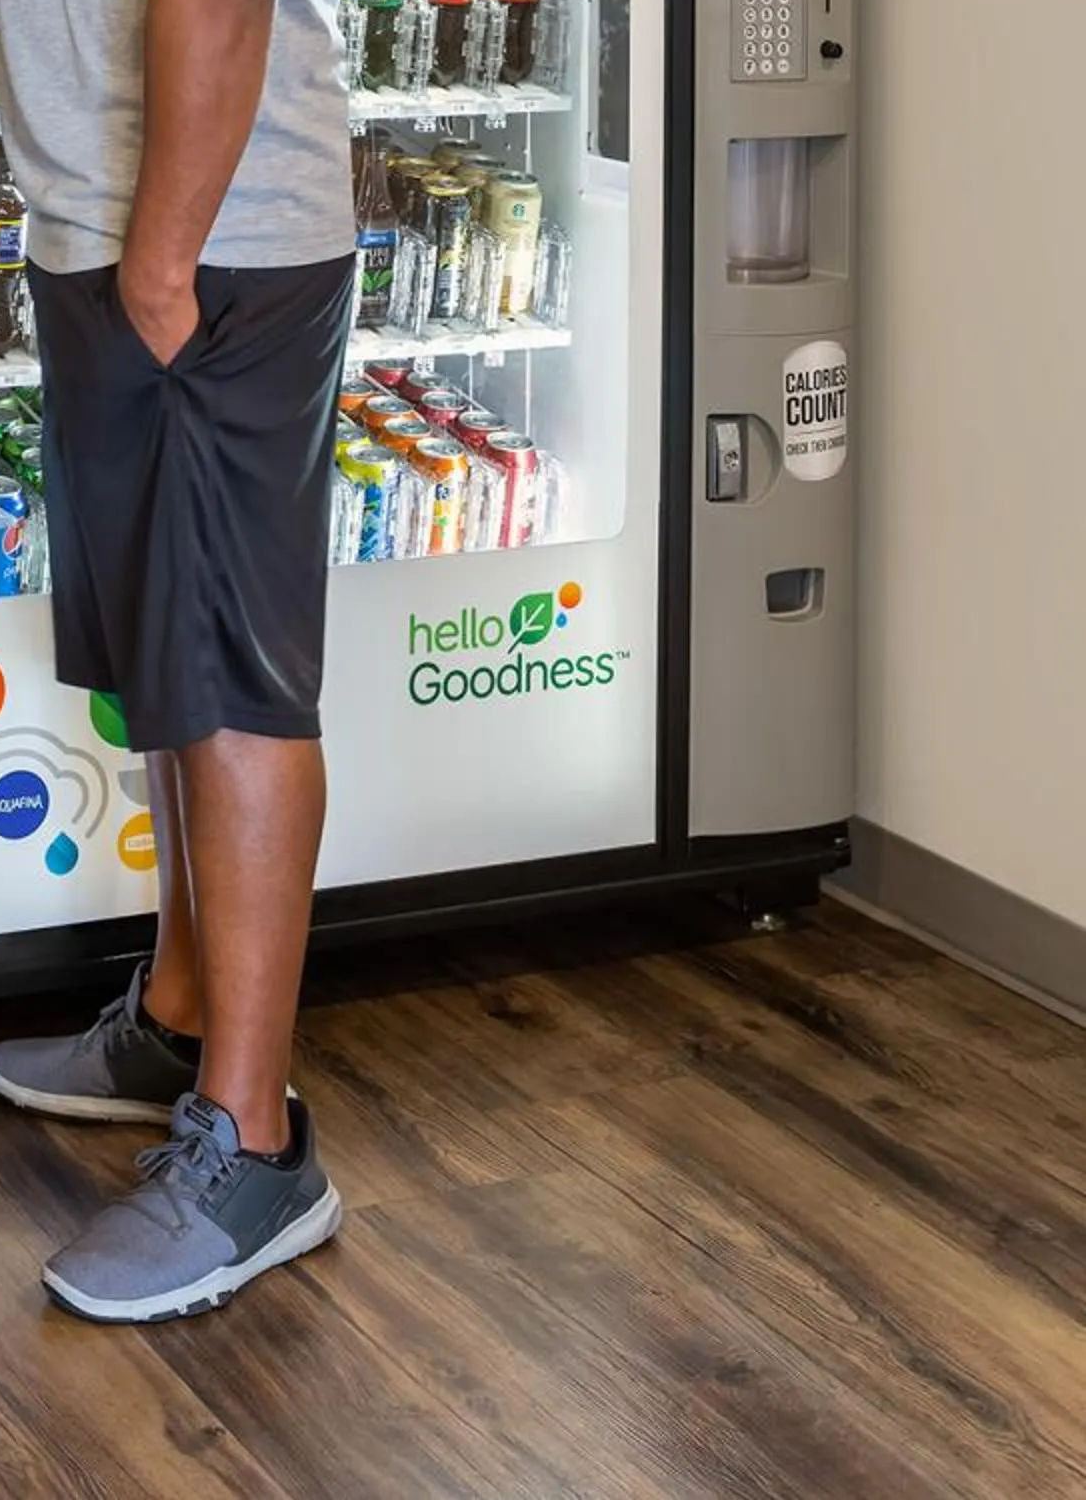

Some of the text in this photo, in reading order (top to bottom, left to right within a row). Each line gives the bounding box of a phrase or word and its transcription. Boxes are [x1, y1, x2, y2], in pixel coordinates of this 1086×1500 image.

[785, 364, 848, 394] CALORIES
[786, 388, 847, 427] COUNT
[409, 607, 505, 655] hello
[408, 652, 615, 706] Goodness
